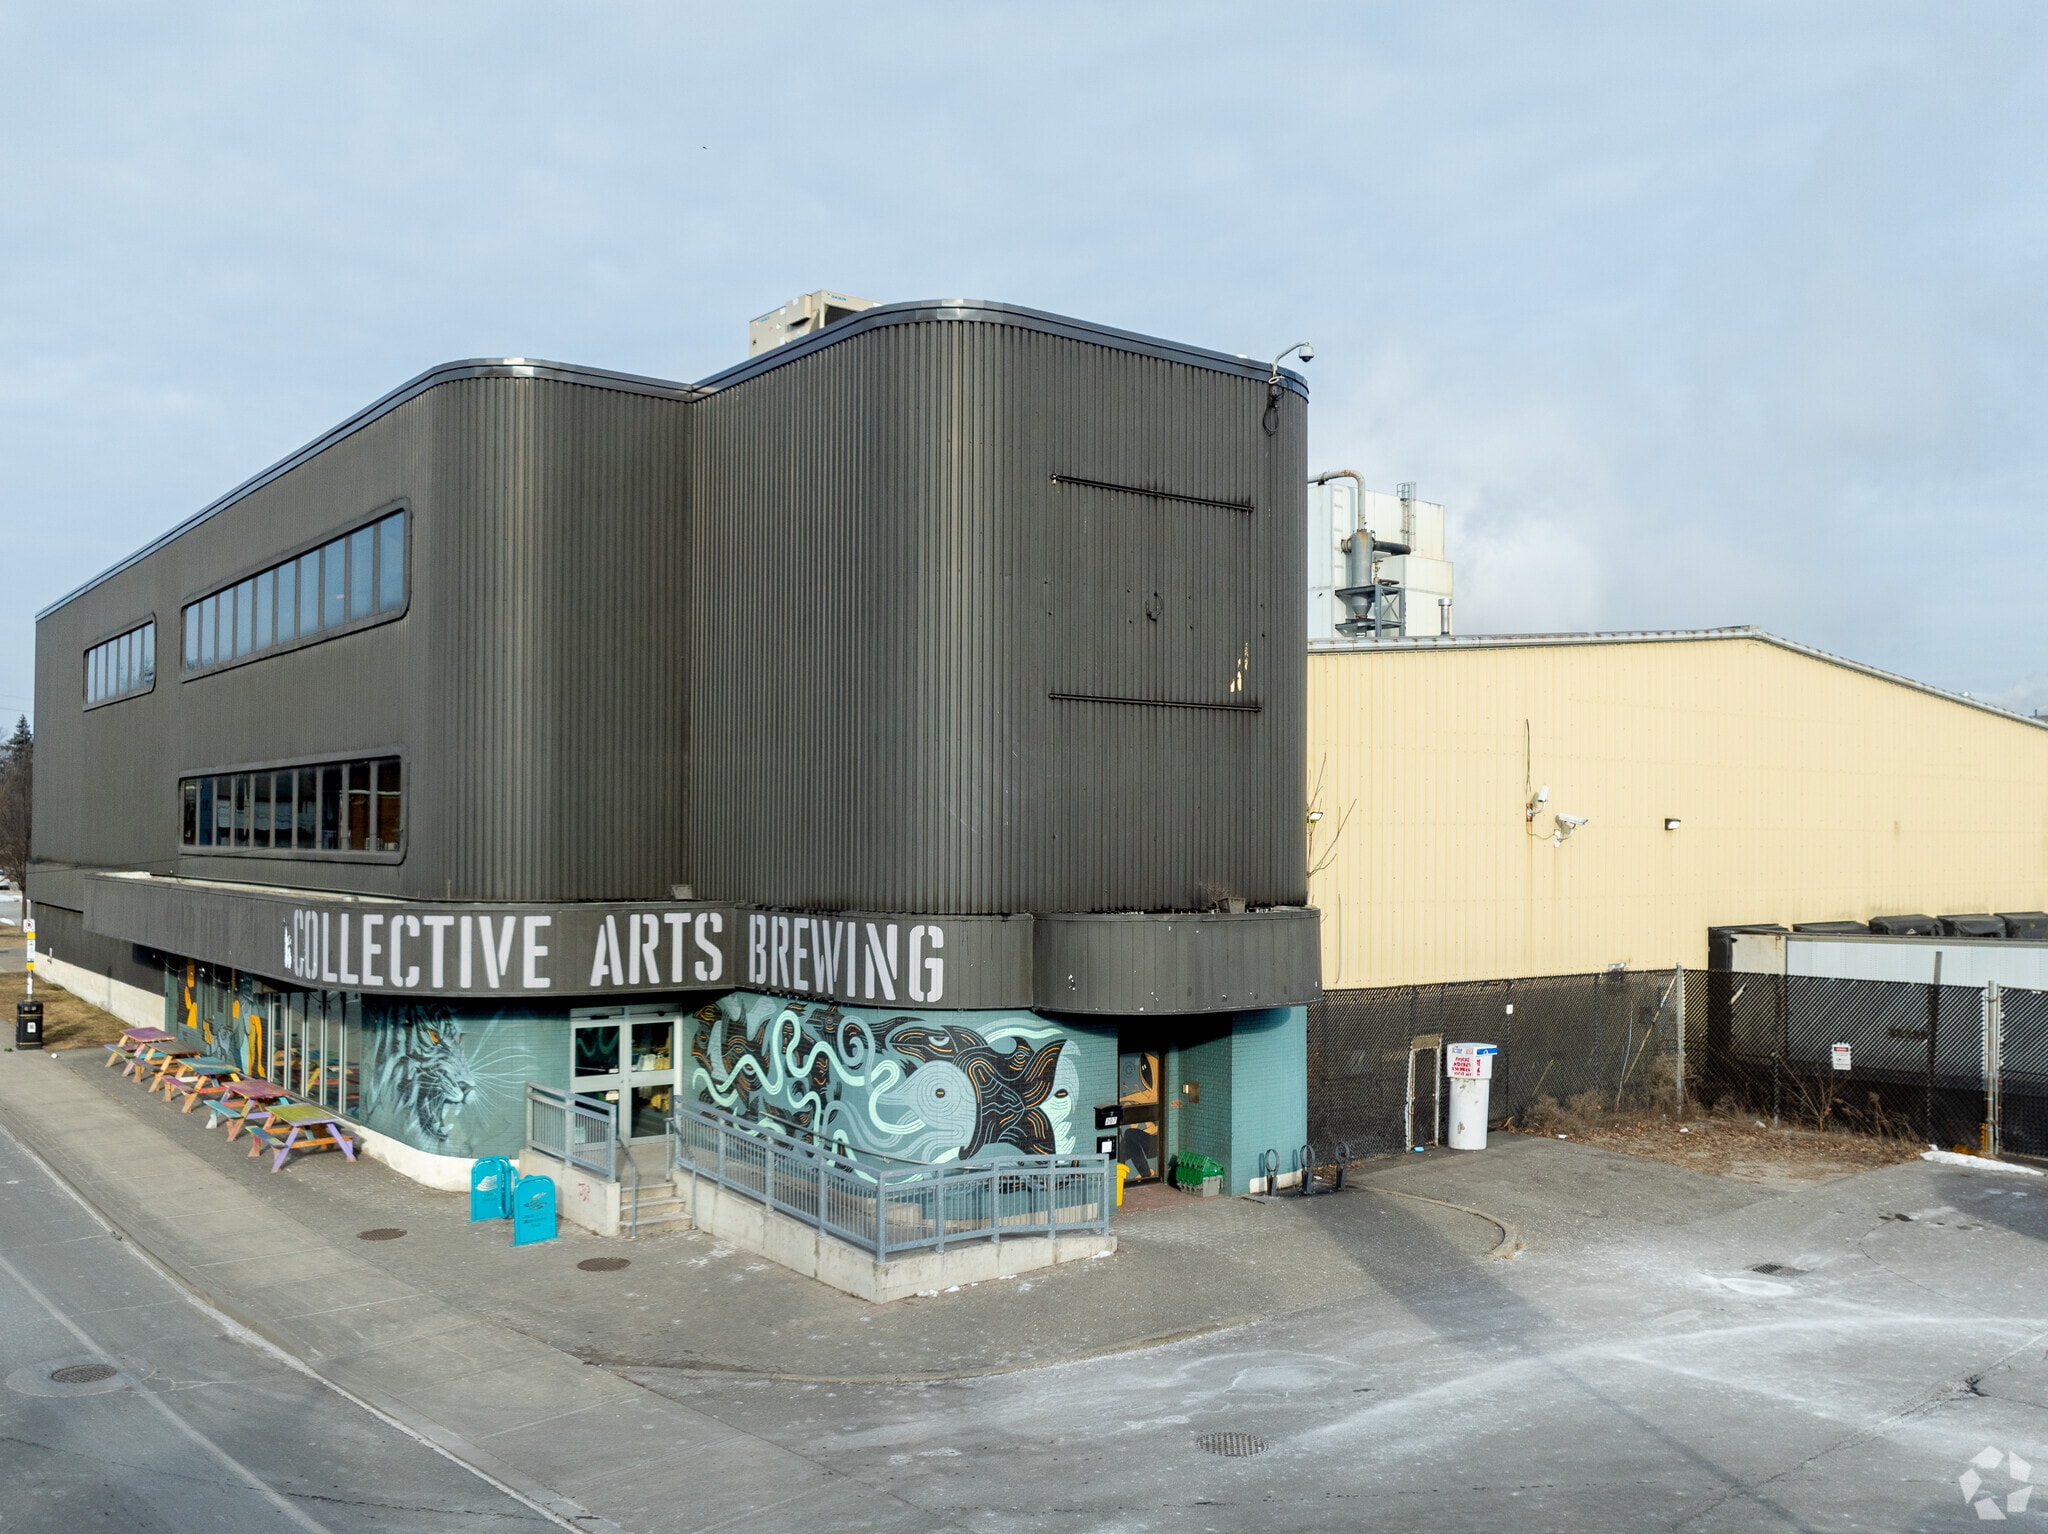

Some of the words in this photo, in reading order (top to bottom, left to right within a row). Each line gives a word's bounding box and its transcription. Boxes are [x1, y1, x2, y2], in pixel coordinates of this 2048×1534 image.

[293, 908, 551, 989] COLLECTIVE
[589, 912, 723, 987] ARTS
[749, 914, 945, 1003] BREWING
